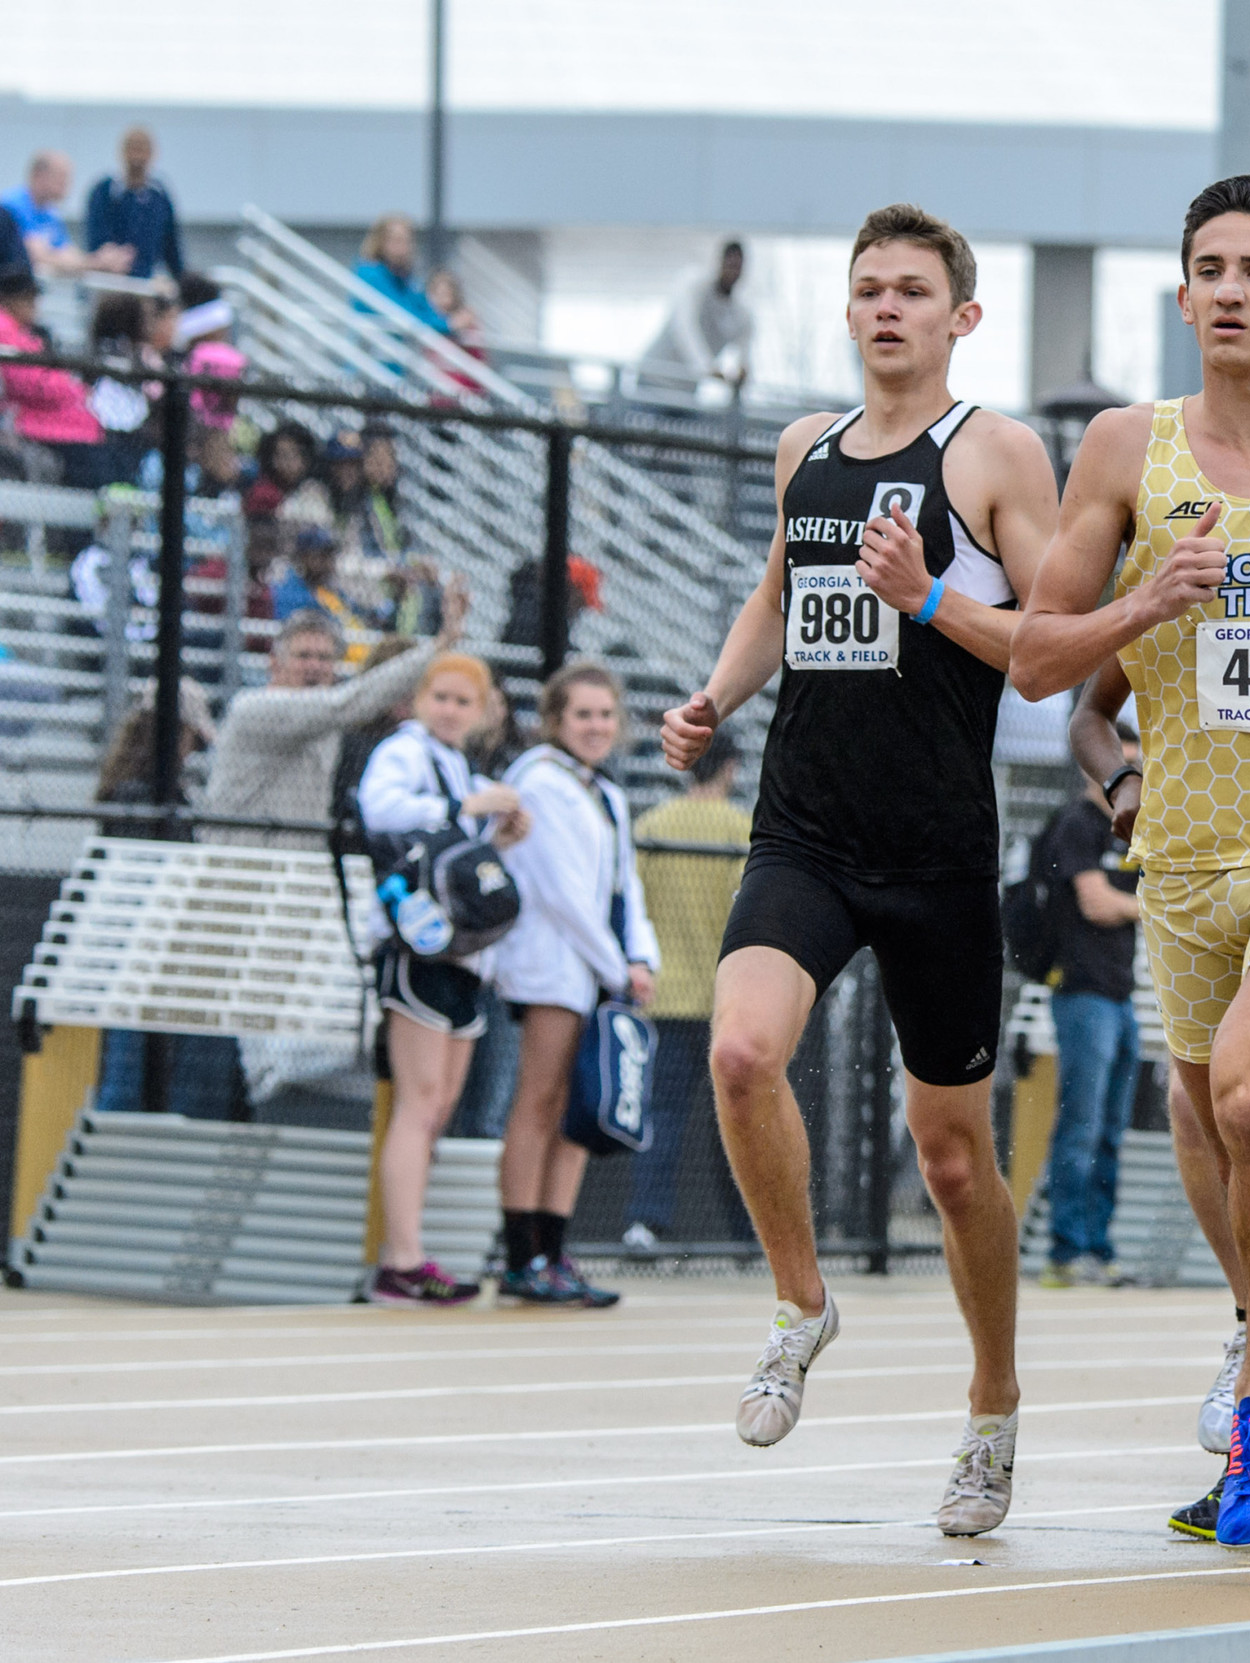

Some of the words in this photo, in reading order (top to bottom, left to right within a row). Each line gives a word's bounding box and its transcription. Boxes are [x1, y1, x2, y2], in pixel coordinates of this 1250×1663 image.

[786, 517, 866, 546] ASHEVI
[797, 576, 852, 589] GEORGIA
[801, 593, 879, 644] 980
[794, 651, 831, 663] TRACK
[836, 651, 846, 662] &
[851, 651, 889, 662] FIELD
